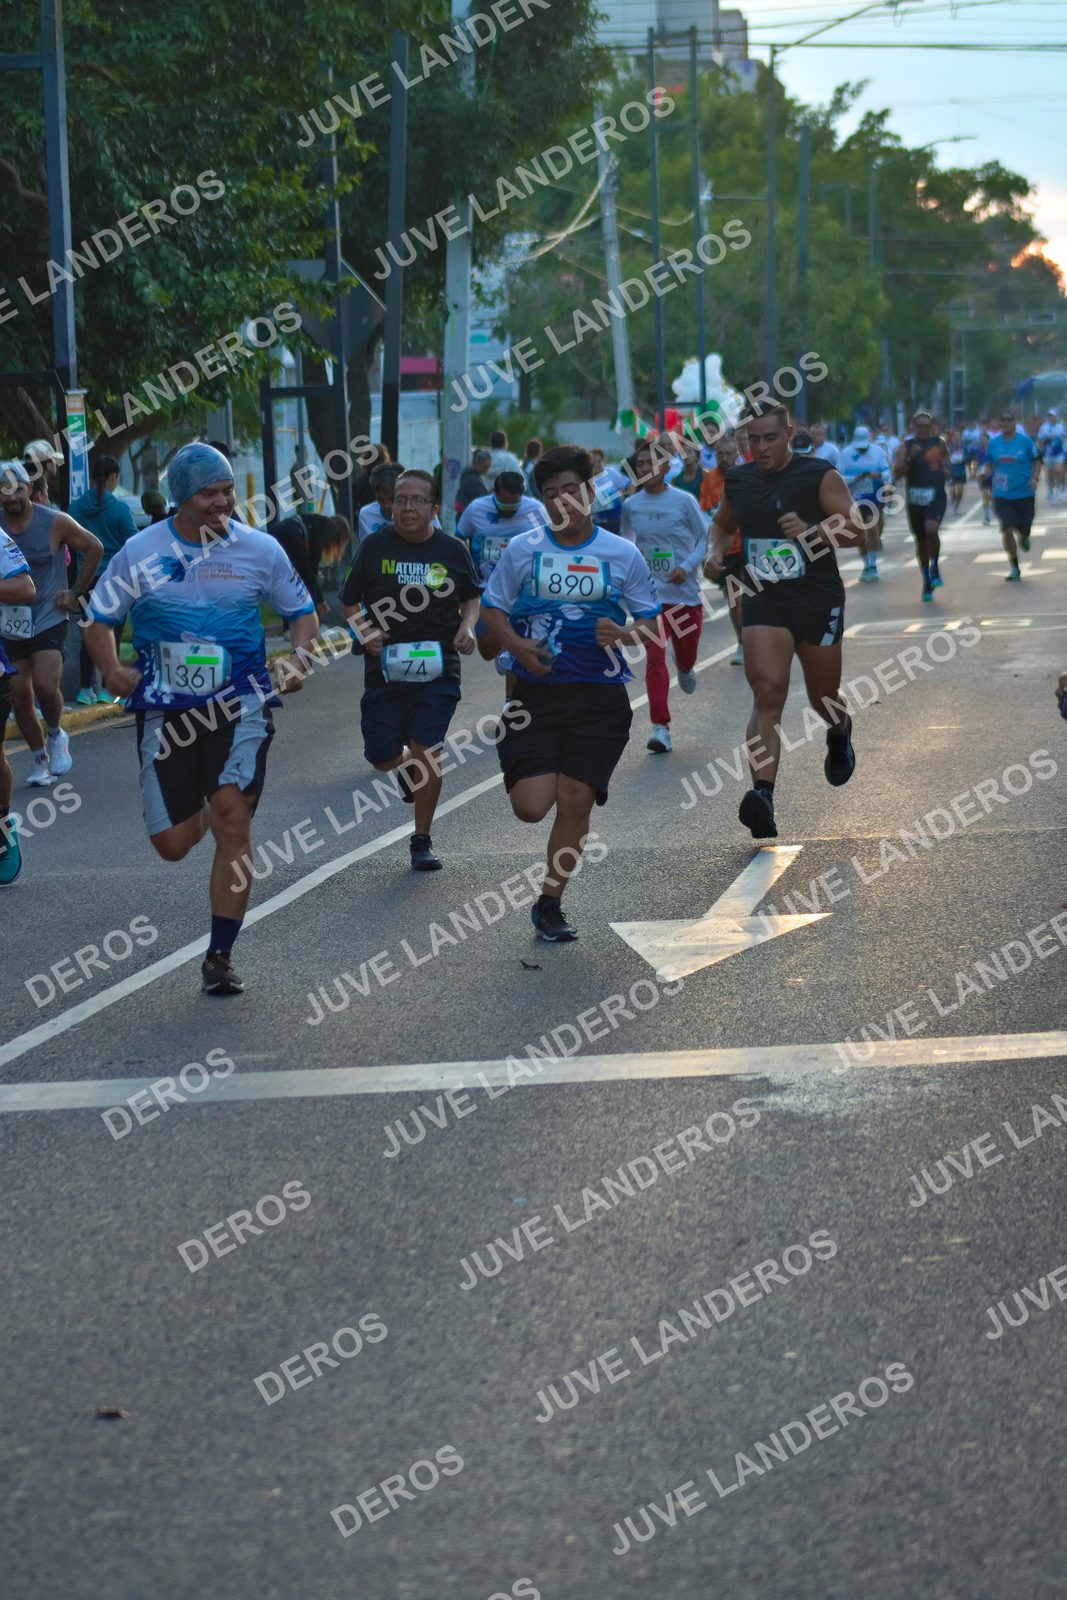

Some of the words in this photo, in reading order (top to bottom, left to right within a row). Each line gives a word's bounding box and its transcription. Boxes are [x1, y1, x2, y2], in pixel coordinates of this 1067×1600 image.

[548, 573, 594, 597] 890
[4, 619, 31, 634] 592
[164, 663, 216, 689] 1361
[401, 660, 428, 676] 74
